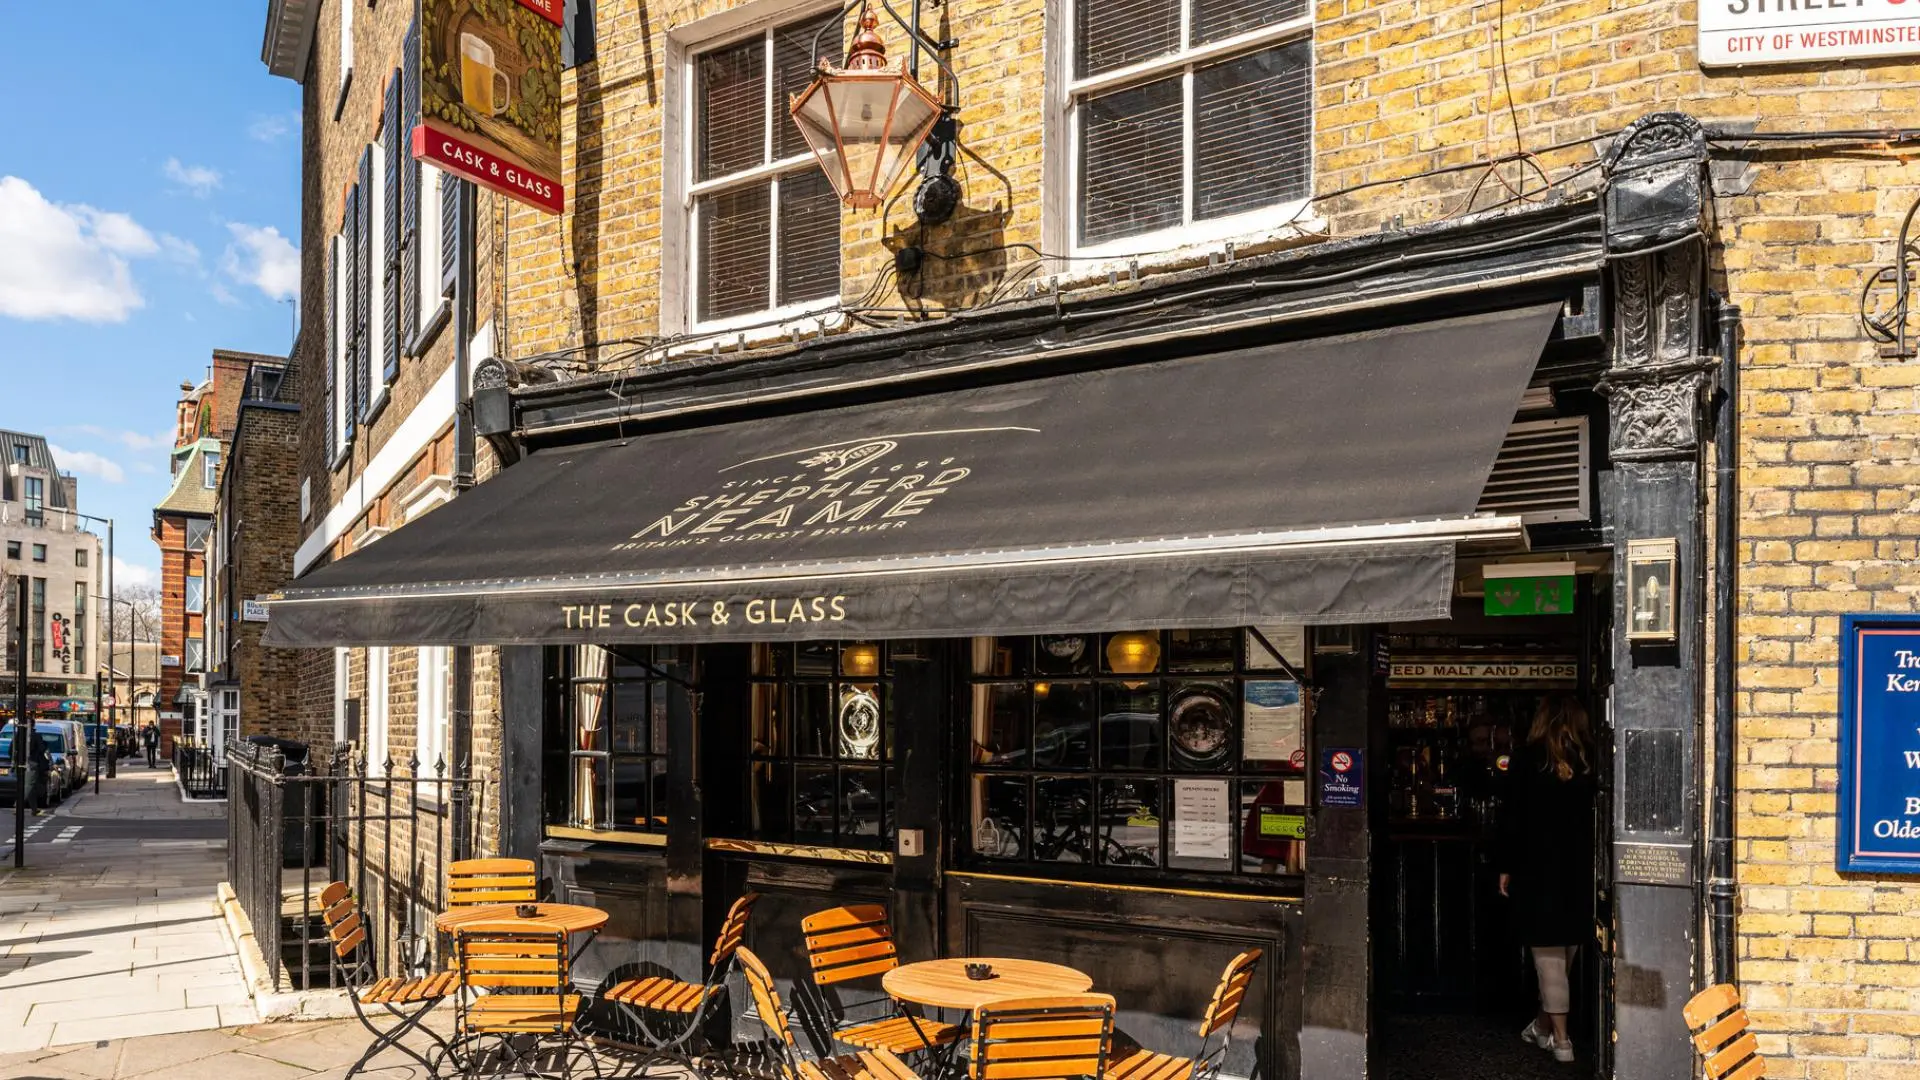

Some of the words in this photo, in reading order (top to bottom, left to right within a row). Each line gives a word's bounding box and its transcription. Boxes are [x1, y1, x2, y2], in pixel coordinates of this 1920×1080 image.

[1727, 35, 1765, 53] CITY
[1773, 34, 1793, 50] OF
[1800, 26, 1920, 48] WESTMINSTE
[442, 142, 484, 170] CASK
[490, 162, 500, 177] &
[506, 169, 551, 199] GLASS
[673, 467, 971, 513] SHEPHERD
[722, 473, 807, 489] SINCE
[630, 487, 948, 539] NEAME
[719, 529, 804, 543] OLDEST
[810, 520, 907, 537] BREWER
[562, 604, 611, 628] THE
[624, 602, 698, 627] CASK
[711, 600, 730, 625] &
[745, 595, 846, 625] GLASS
[62, 618, 70, 674] PALACE
[1433, 666, 1476, 676] MALT
[1482, 666, 1519, 676] AND
[1529, 666, 1575, 676] HOPS
[1324, 783, 1360, 794] Smoking
[1335, 774, 1348, 783] No
